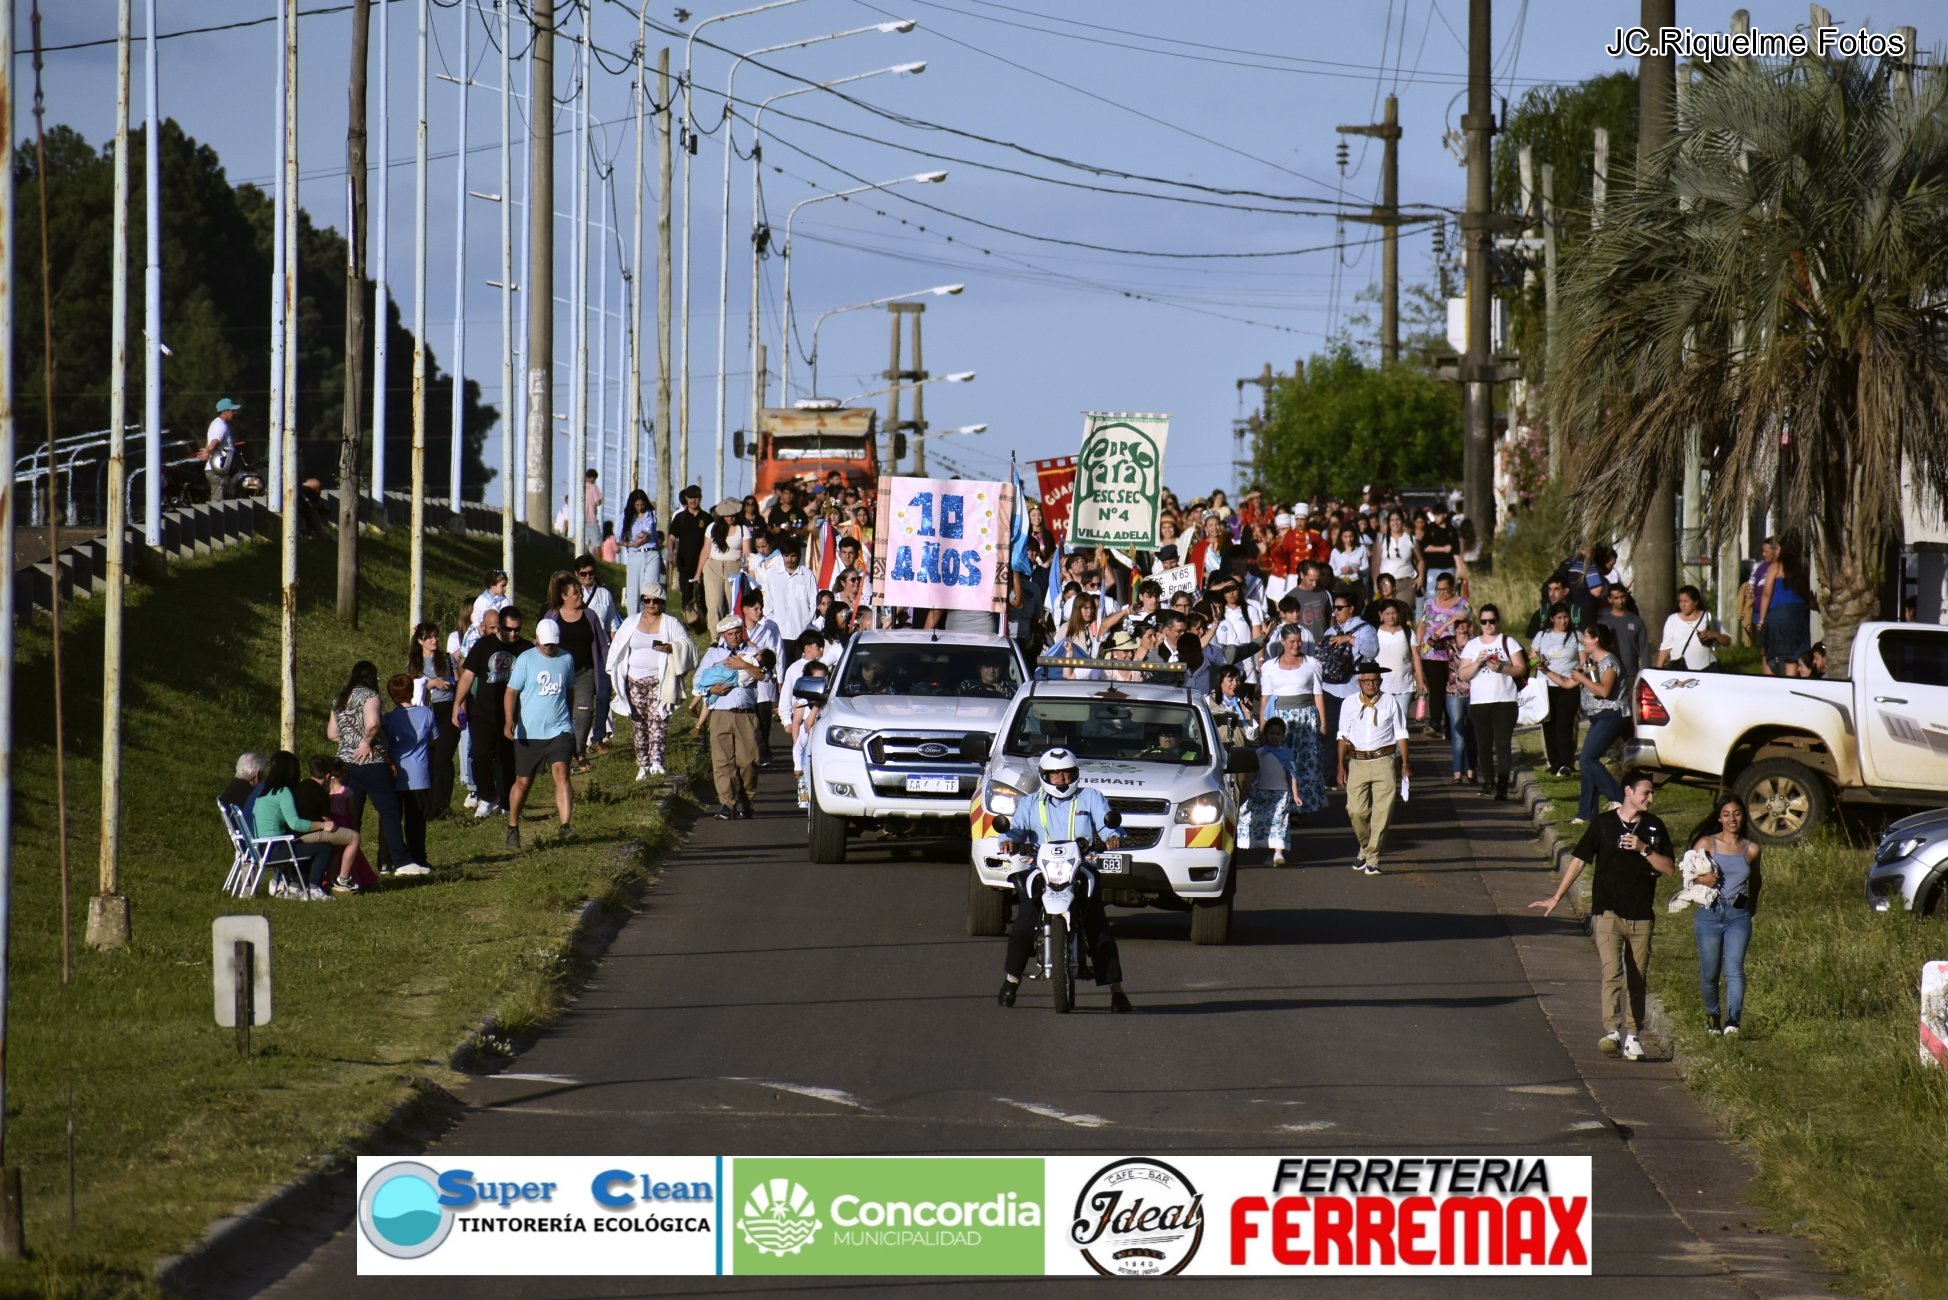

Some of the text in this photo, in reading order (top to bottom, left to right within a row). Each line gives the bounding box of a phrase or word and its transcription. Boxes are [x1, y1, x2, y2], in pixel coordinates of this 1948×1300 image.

[1093, 489, 1140, 504] ESC SEC
[908, 491, 964, 540] 10
[1119, 509, 1129, 521] 4
[1078, 528, 1149, 540] VILLA ADELA
[891, 541, 982, 587] AÑOS
[1169, 581, 1192, 595] Brown
[537, 670, 562, 696] Boo!
[1054, 847, 1063, 855] 5
[1103, 859, 1121, 870] 683
